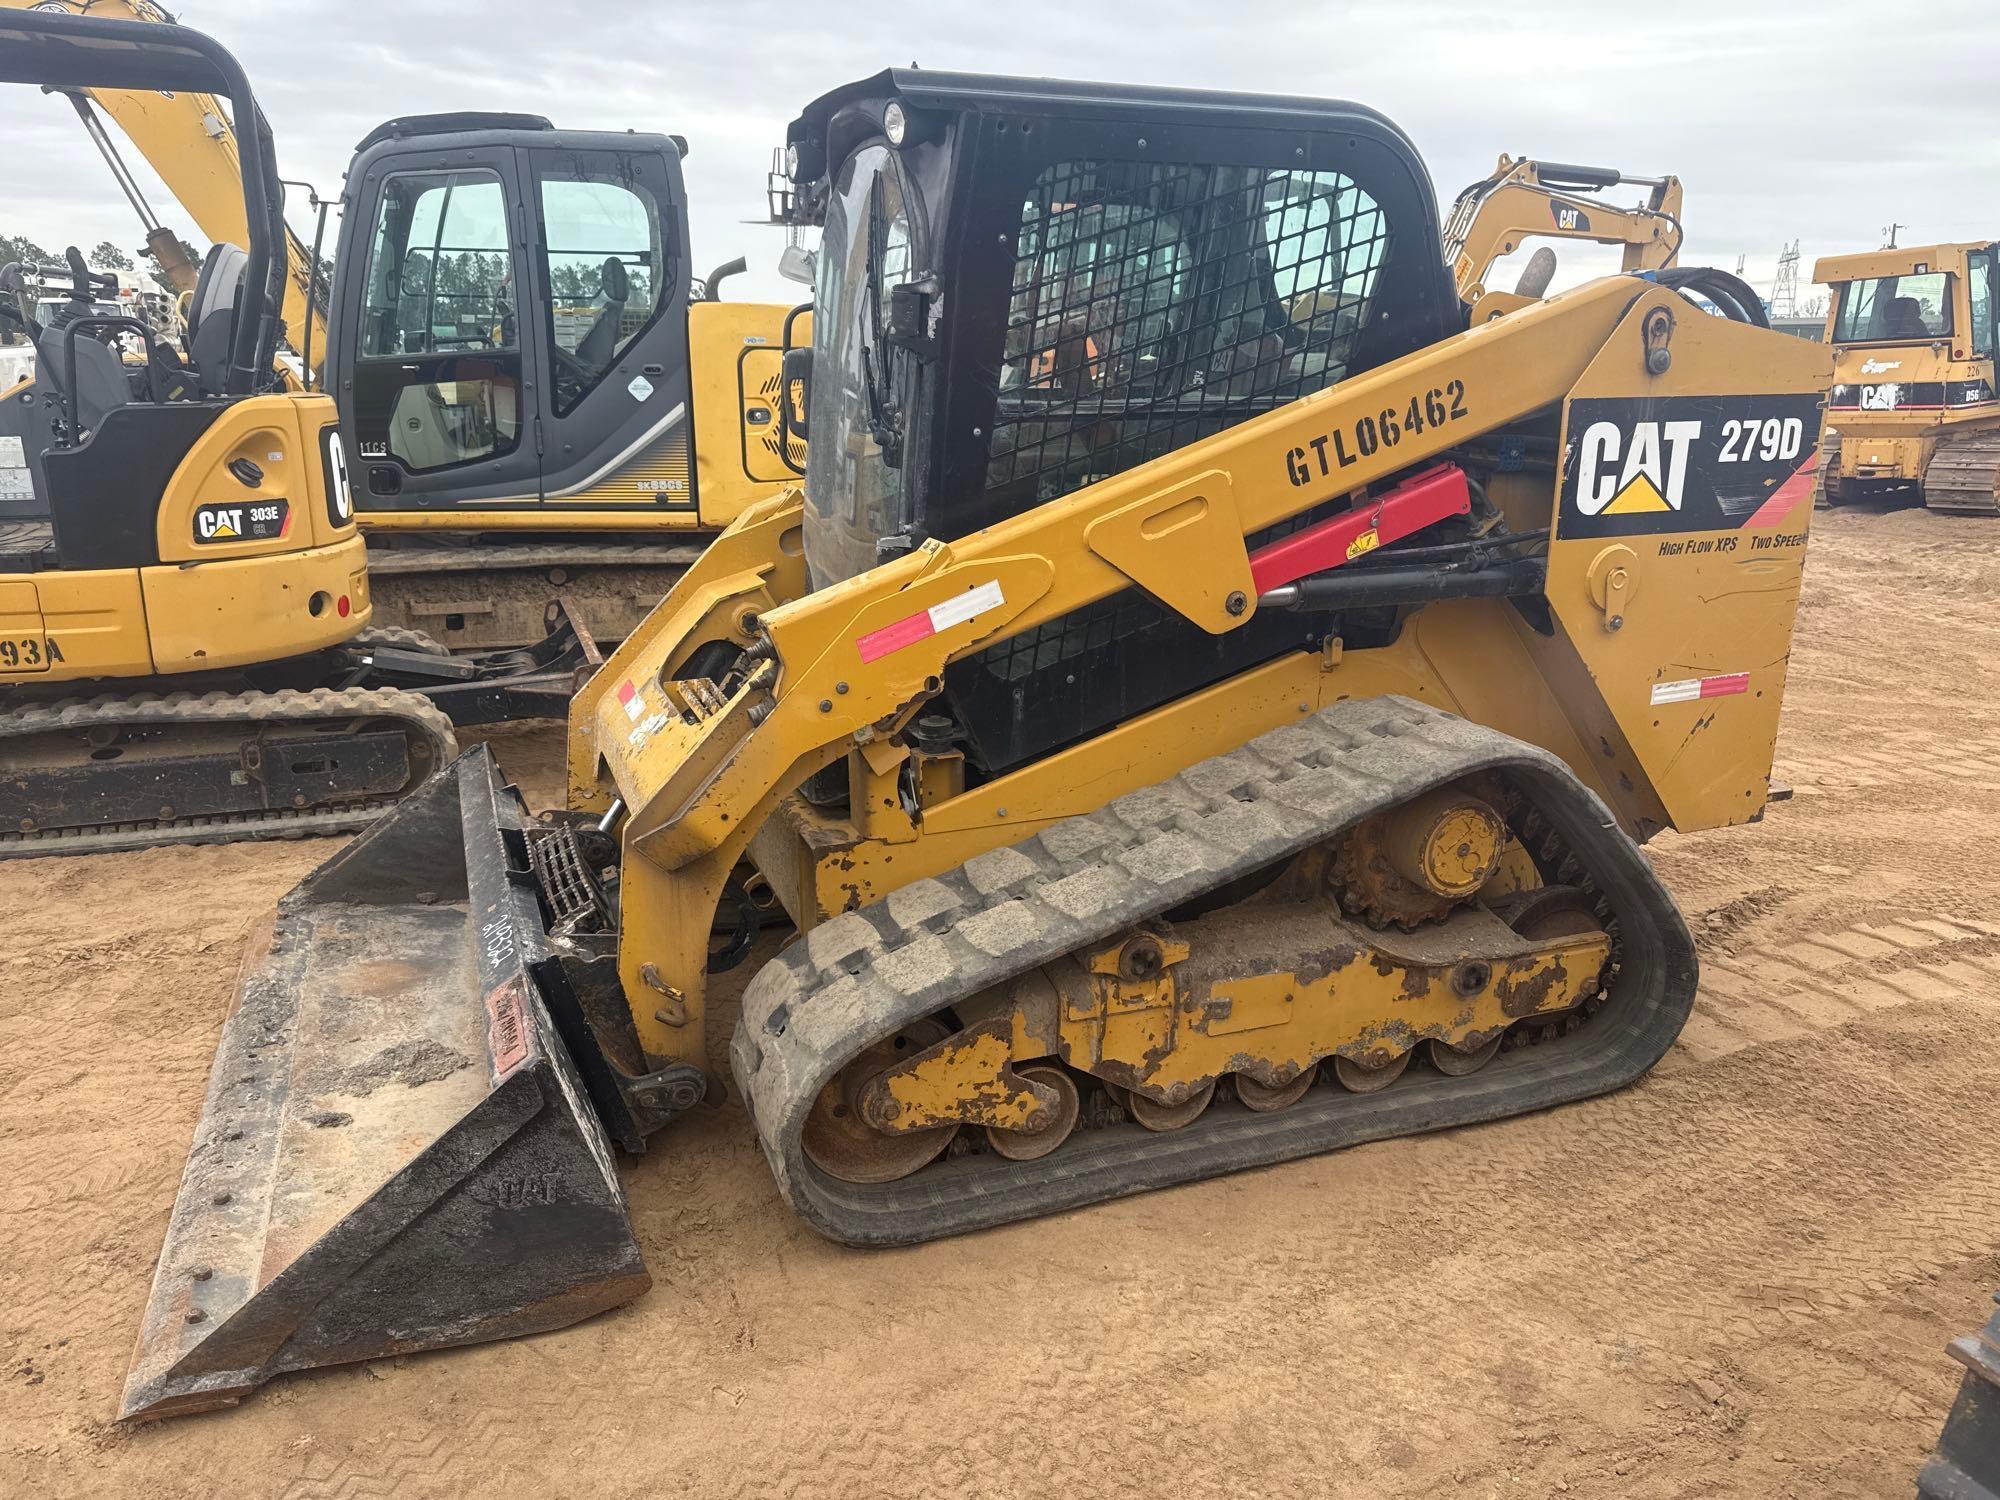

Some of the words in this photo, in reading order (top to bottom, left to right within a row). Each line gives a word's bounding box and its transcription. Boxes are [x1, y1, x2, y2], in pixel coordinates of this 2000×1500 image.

[1559, 209, 1579, 229] CAT
[1966, 366, 1981, 378] 226
[1285, 379, 1469, 487] GTL06462
[1576, 420, 1702, 516] CAT
[1718, 417, 1804, 463] 279D
[198, 509, 243, 538] CAT
[250, 506, 279, 522] 303E
[1714, 536, 1739, 551] XPS
[498, 1172, 562, 1209] CAT
